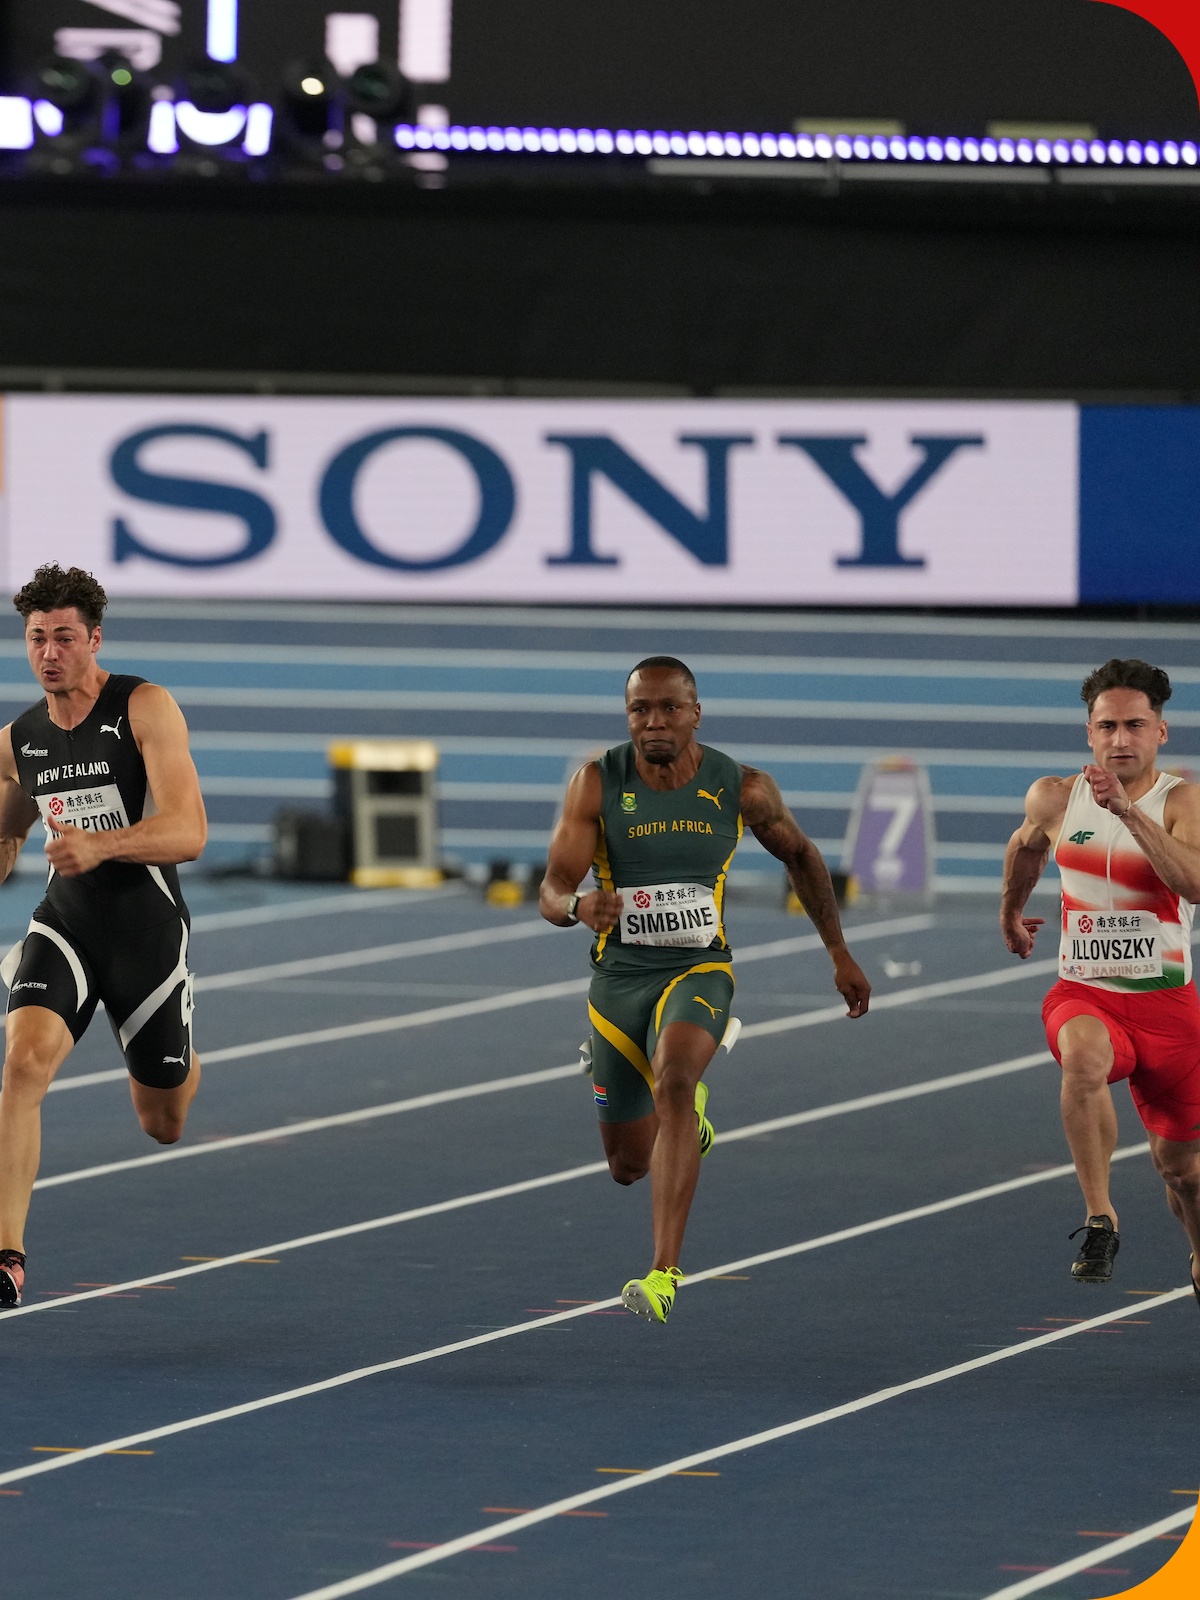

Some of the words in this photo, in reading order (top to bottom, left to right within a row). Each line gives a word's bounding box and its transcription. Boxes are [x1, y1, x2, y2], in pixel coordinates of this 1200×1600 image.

[105, 420, 986, 575] SONY
[36, 766, 60, 787] NEW
[62, 760, 111, 779] ZEALAND
[628, 820, 666, 839] SOUTH
[671, 820, 713, 835] AFRICA
[869, 795, 918, 862] 7
[1068, 830, 1095, 845] 4F
[626, 906, 714, 935] SIMBINE
[1072, 937, 1155, 961] ILLOVSZKY
[1091, 964, 1141, 977] NANJING
[1143, 963, 1156, 973] 25
